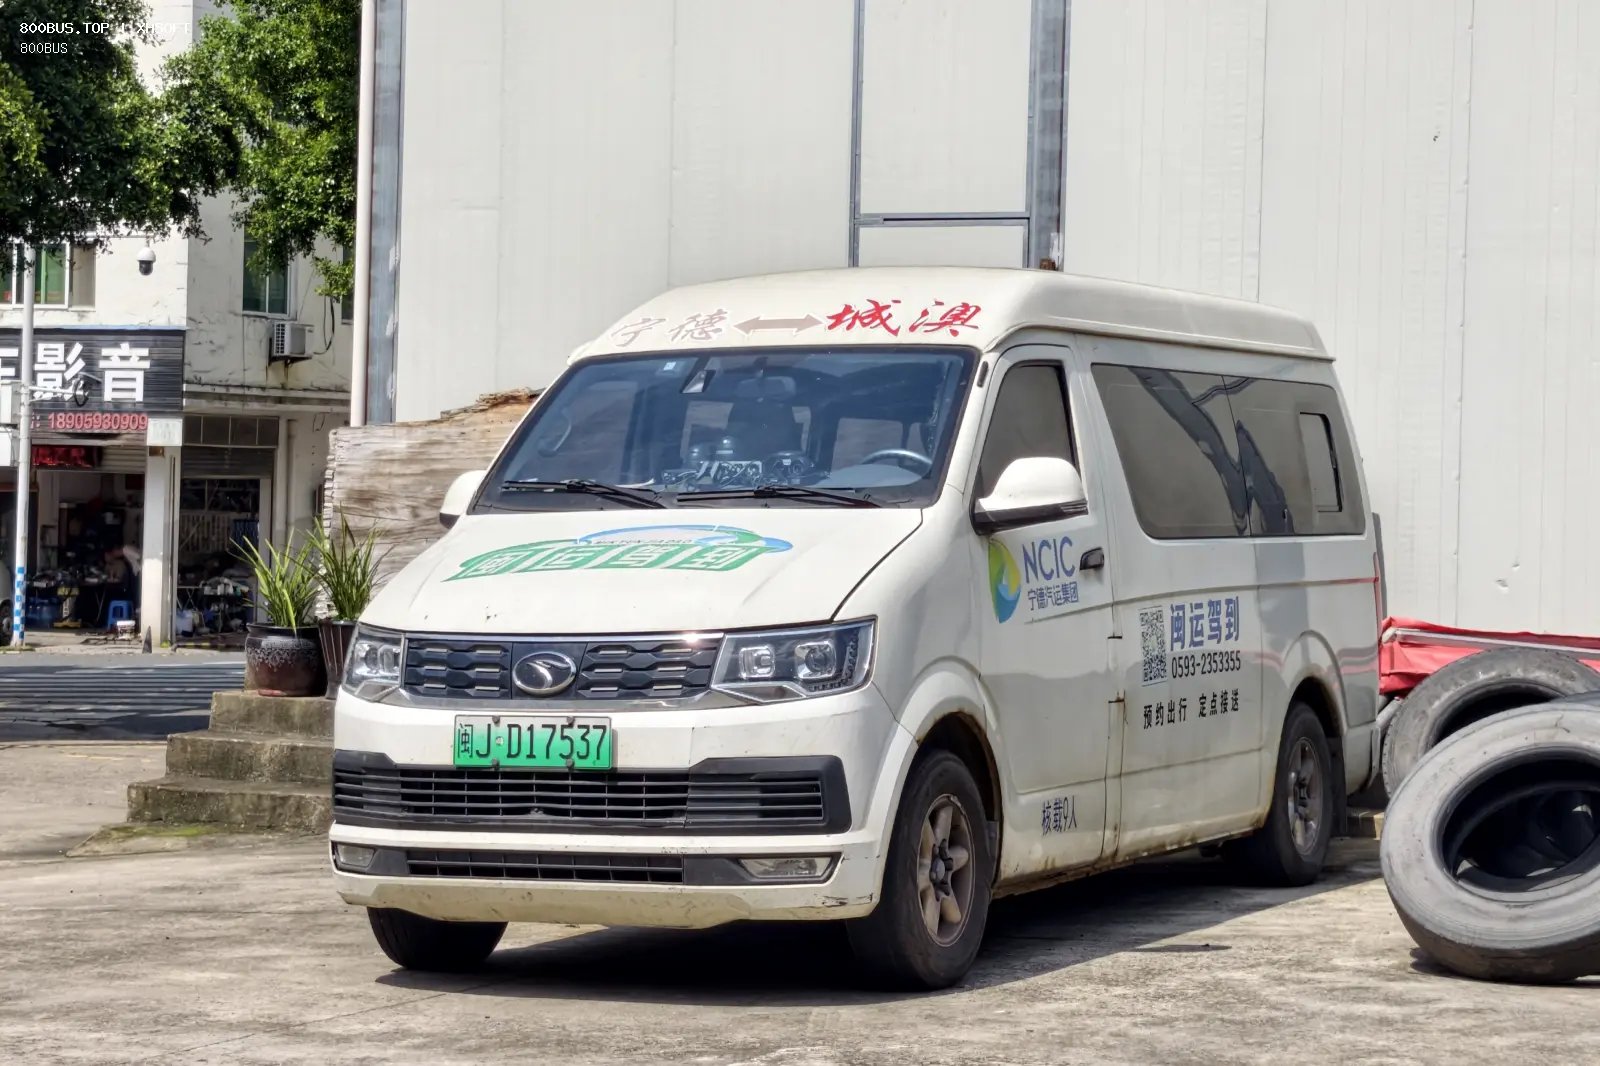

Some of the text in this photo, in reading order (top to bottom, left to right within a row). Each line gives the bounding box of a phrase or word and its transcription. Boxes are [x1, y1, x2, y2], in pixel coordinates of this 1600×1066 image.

[826, 299, 982, 337] 城澳
[48, 412, 148, 430] 18905930909
[1022, 536, 1075, 584] NCIC
[1027, 581, 1080, 611] 宁德汽运集团
[1170, 596, 1239, 651] 闽运驾到
[1171, 650, 1241, 679] 0593-2353355
[1143, 688, 1239, 730] 预约出行 定点接送
